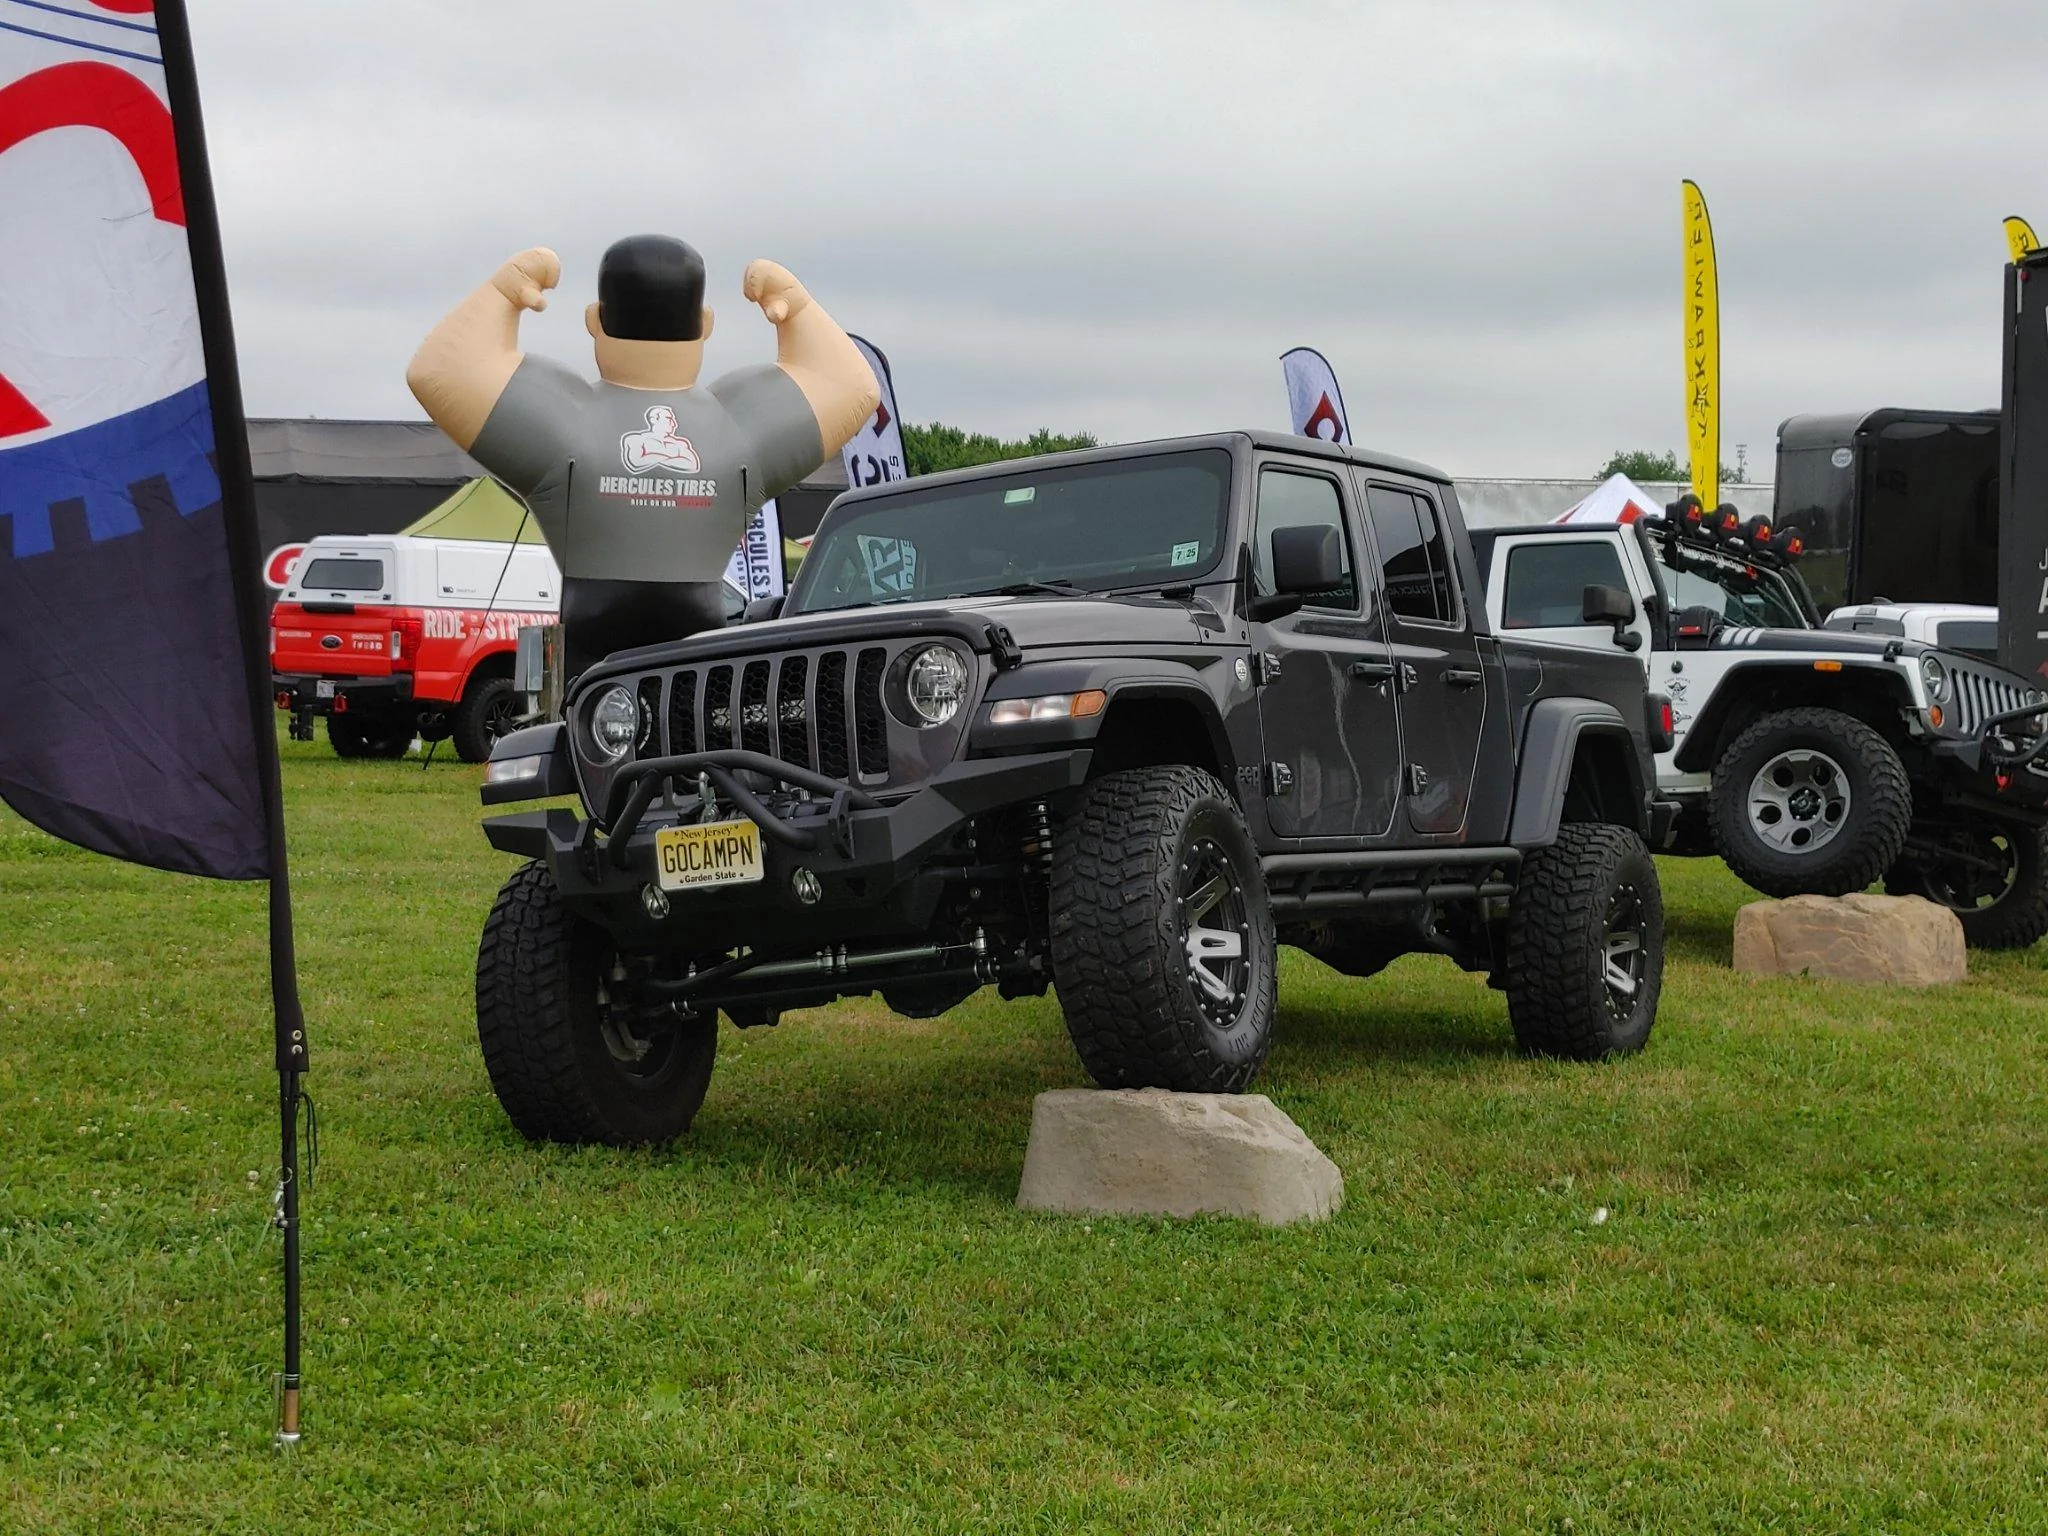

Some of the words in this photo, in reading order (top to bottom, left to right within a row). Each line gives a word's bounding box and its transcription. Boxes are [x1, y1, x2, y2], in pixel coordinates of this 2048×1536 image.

[599, 476, 674, 496] HERCULES
[1176, 550, 1182, 560] 7
[1186, 548, 1196, 558] 25
[424, 609, 467, 639] RIDE
[681, 830, 701, 840] New
[703, 827, 733, 839] Jersey
[663, 835, 754, 873] GOCAMPN
[684, 873, 713, 884] Garden
[715, 871, 737, 880] State
